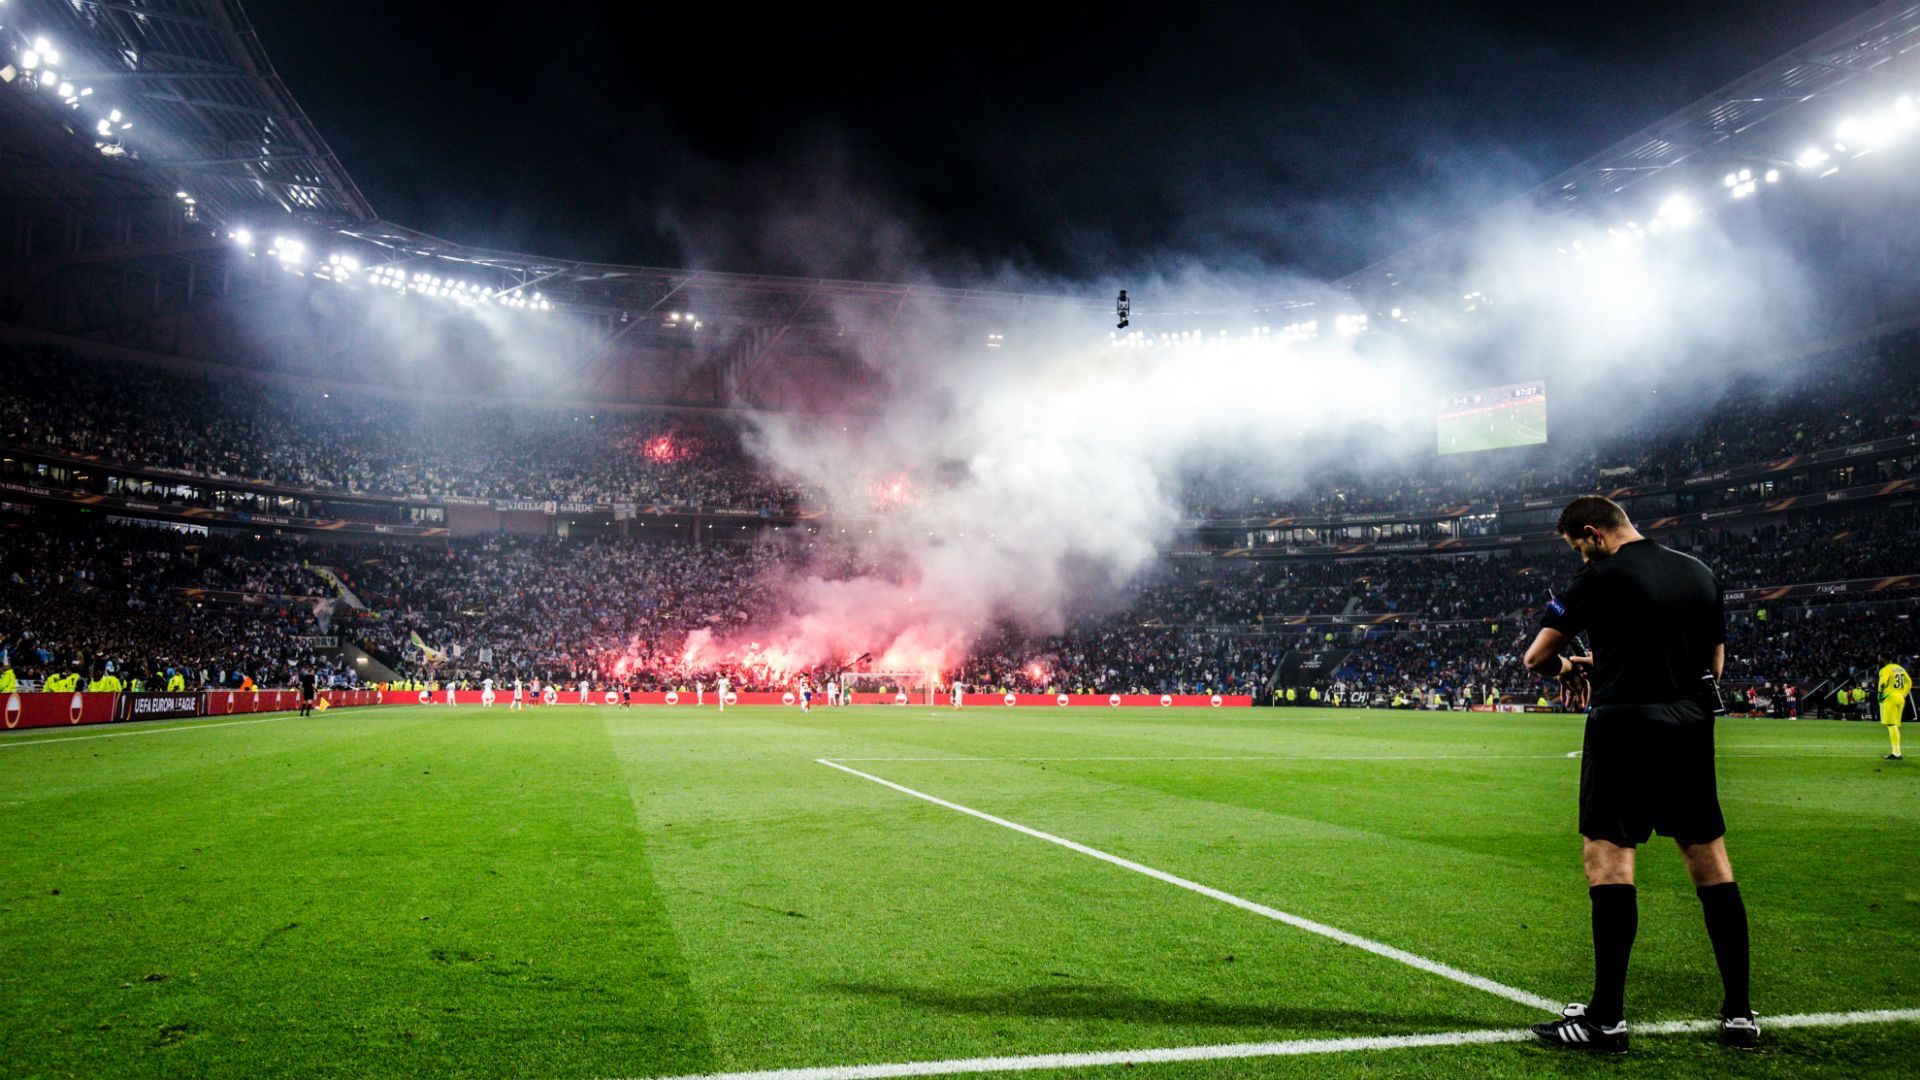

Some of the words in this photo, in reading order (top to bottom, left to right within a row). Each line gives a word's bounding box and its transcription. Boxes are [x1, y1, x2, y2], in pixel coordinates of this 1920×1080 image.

[6, 483, 26, 491] EUROPA
[27, 487, 50, 496] LEAGUE
[560, 503, 593, 513] GARDE
[1822, 584, 1846, 593] UniCredit
[1723, 592, 1744, 600] LEAGUE
[134, 697, 151, 713] UEFA
[152, 697, 175, 712] EUROPA
[175, 697, 196, 711] LEAGUE
